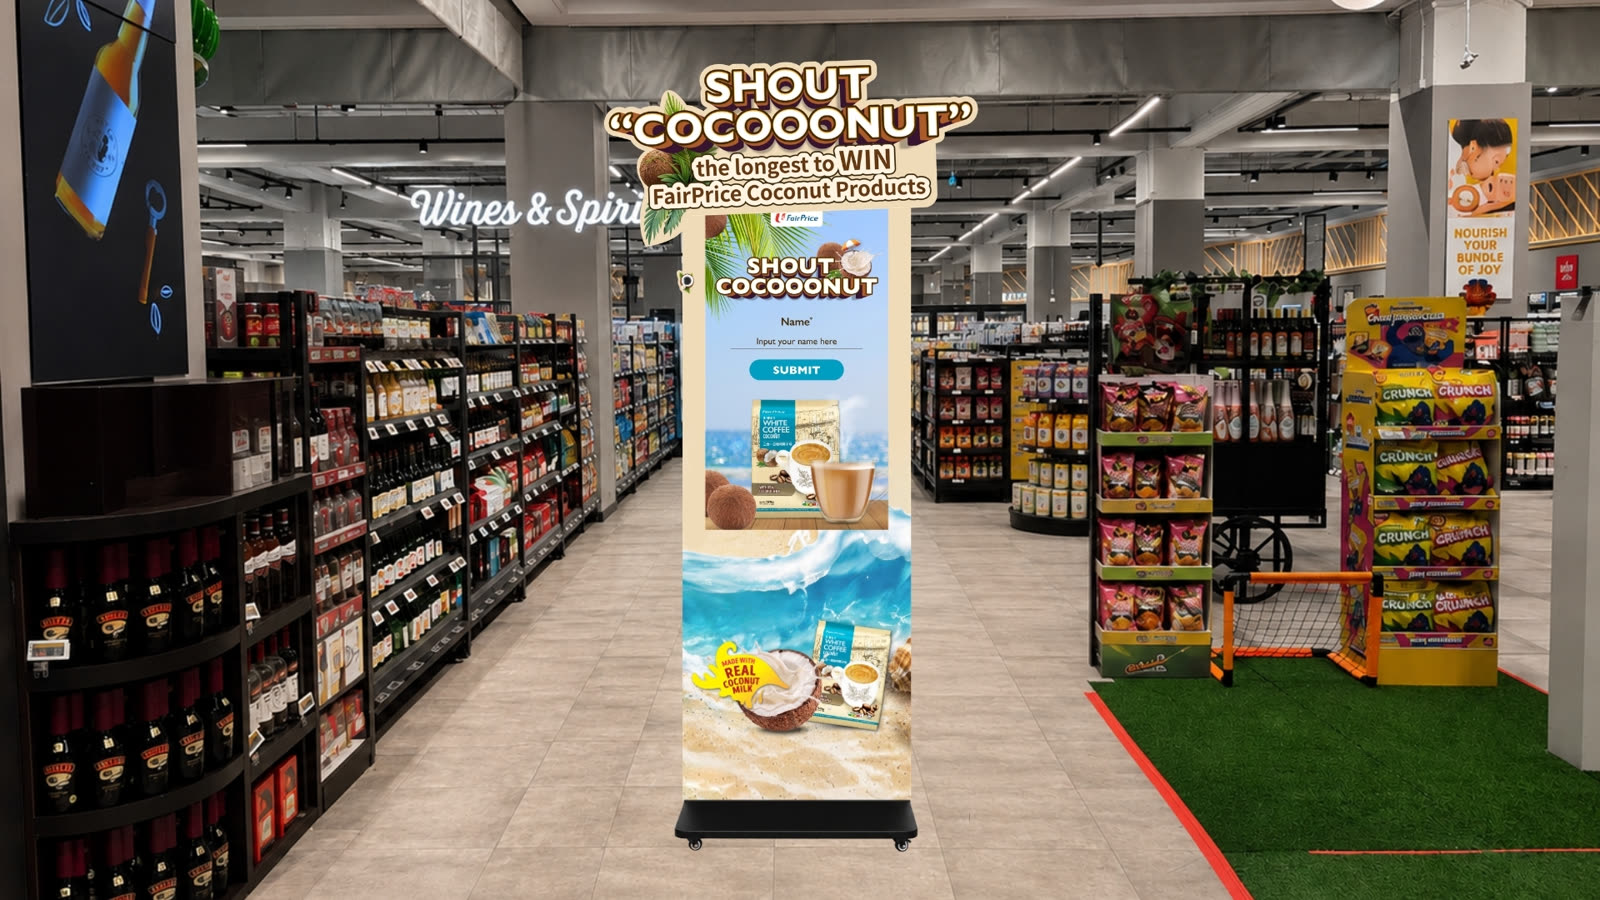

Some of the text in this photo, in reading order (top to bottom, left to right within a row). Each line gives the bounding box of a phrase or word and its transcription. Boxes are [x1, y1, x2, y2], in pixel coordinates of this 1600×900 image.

[705, 65, 871, 106] SHOUT
[696, 149, 891, 179] the longest to WIN
[653, 178, 926, 206] FairPrice Coconut Products
[410, 189, 644, 233] Wines & Spiri
[786, 214, 819, 222] FairPrice
[1454, 227, 1507, 239] NOURISH
[1464, 240, 1497, 250] YOUR
[1457, 252, 1504, 263] BUNDLE
[747, 257, 834, 277] SHOUT
[1458, 264, 1501, 275] OF JOY
[715, 277, 878, 297] COCOOONUT
[756, 337, 776, 347] Input
[777, 339, 795, 348] your
[820, 337, 837, 346] here
[772, 365, 821, 375] SUBMIT
[1383, 388, 1433, 400] CRUNCH
[1438, 385, 1493, 396] CRUNCH
[1378, 530, 1430, 543] CRUNCH
[823, 644, 848, 653] COFFEE
[825, 639, 846, 647] WHITE
[721, 658, 738, 667] MADE
[724, 665, 756, 678] REAL
[722, 677, 760, 688] COCONUT
[732, 685, 753, 694] MILK
